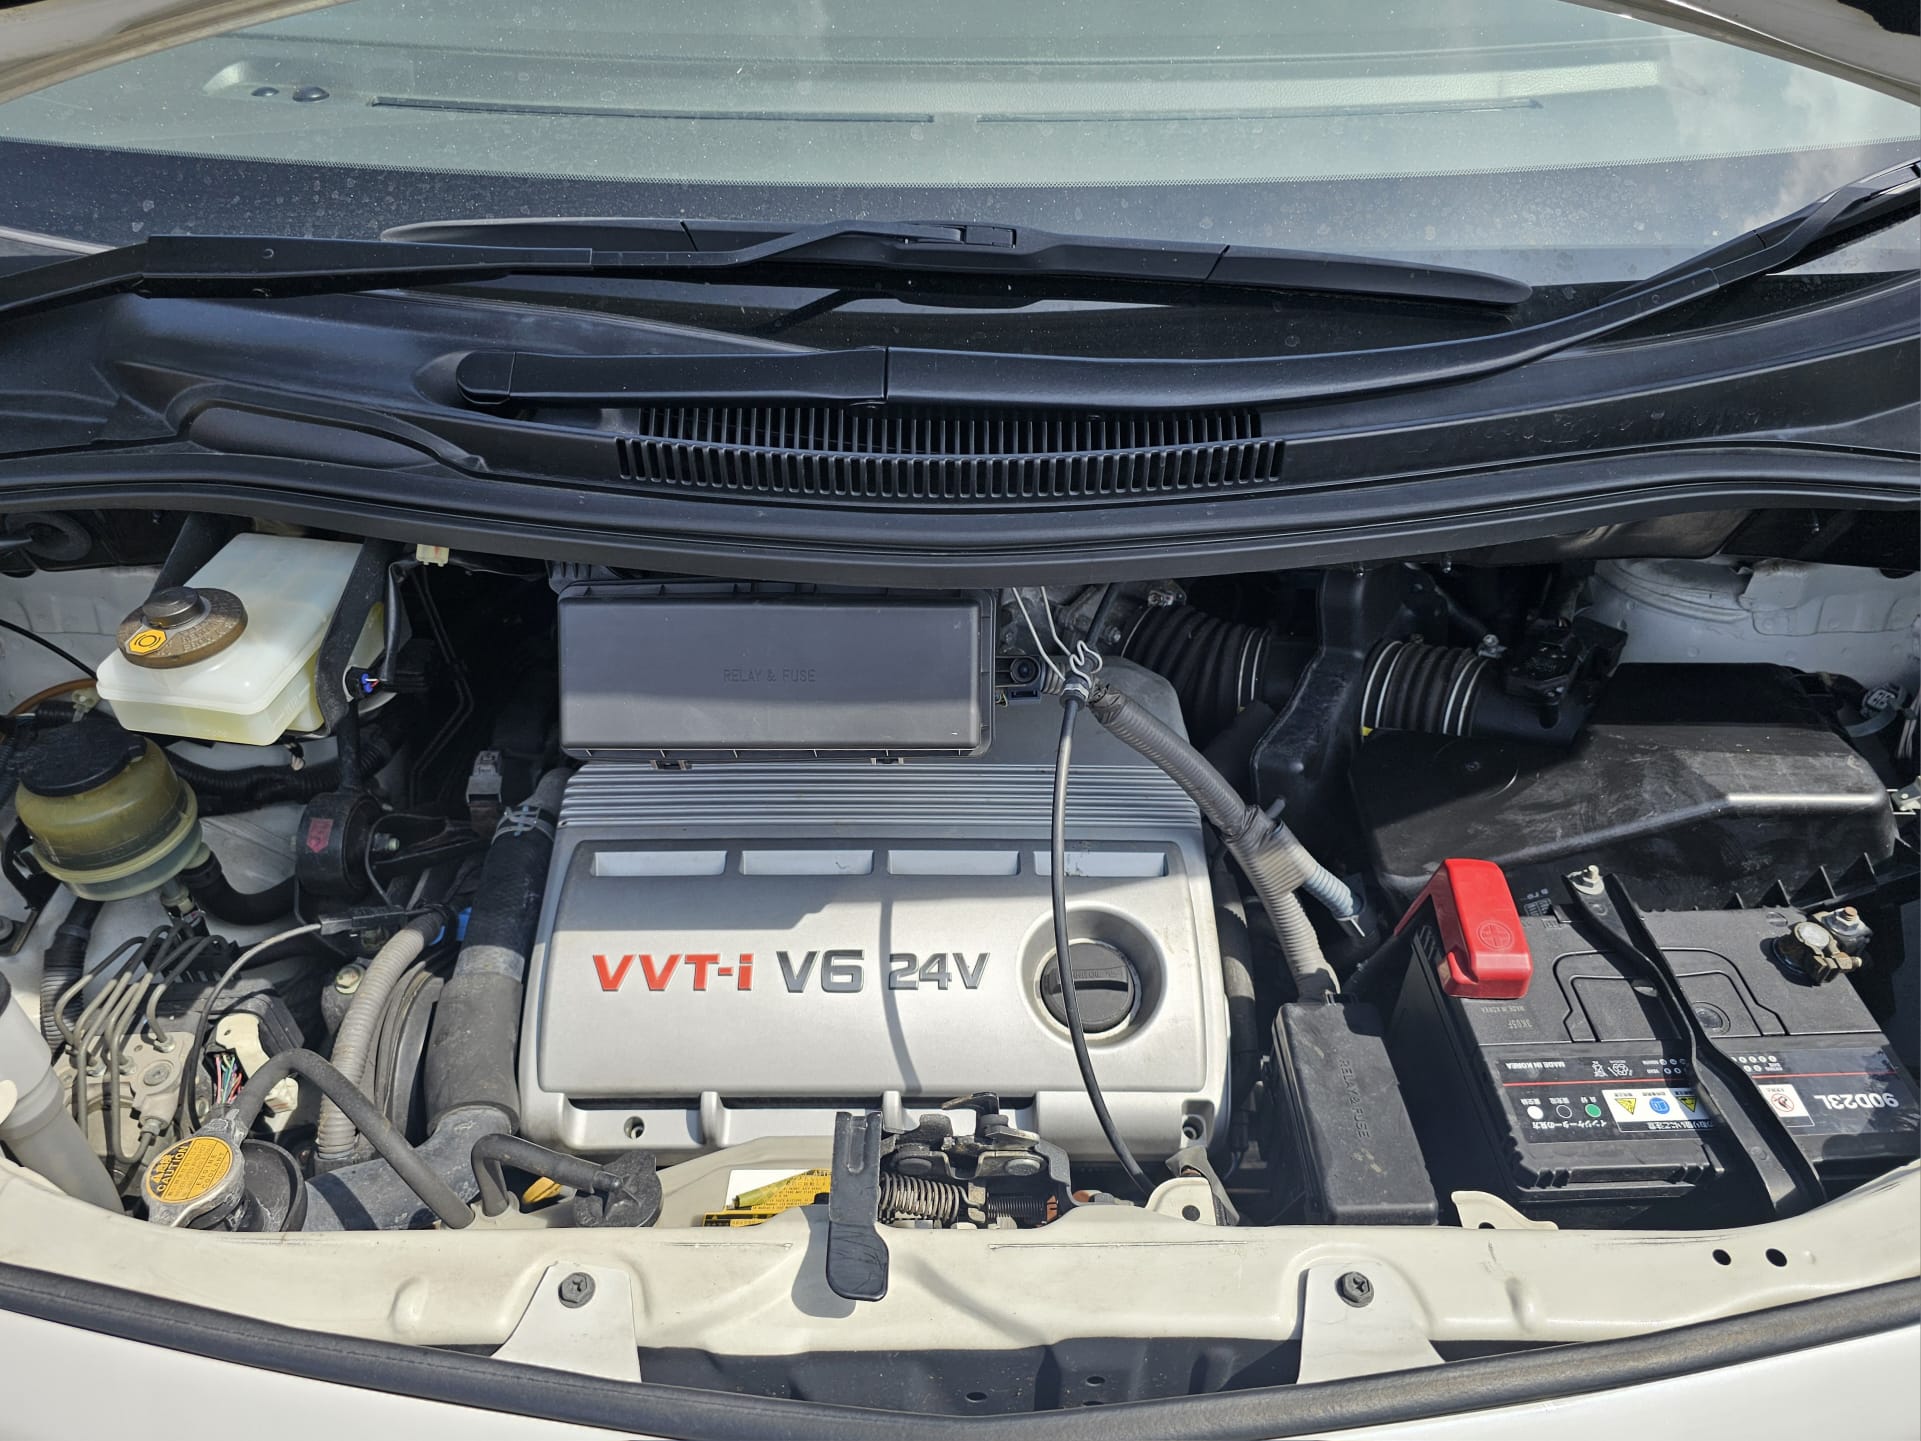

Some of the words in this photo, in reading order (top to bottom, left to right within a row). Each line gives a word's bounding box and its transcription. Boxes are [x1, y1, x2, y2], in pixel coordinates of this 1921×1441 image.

[723, 667, 762, 682] RELAY
[766, 667, 777, 682] &
[782, 667, 817, 682] FUSE
[592, 952, 755, 992] VVT-i
[776, 949, 866, 993] V6
[888, 951, 991, 990] 24V
[1505, 1062, 1533, 1070] KOREA
[1814, 1093, 1900, 1110] 90D23L
[1353, 1108, 1370, 1138] FUSE
[1532, 1120, 1607, 1129] インジケーターの見方
[157, 1146, 188, 1192] CAUTION
